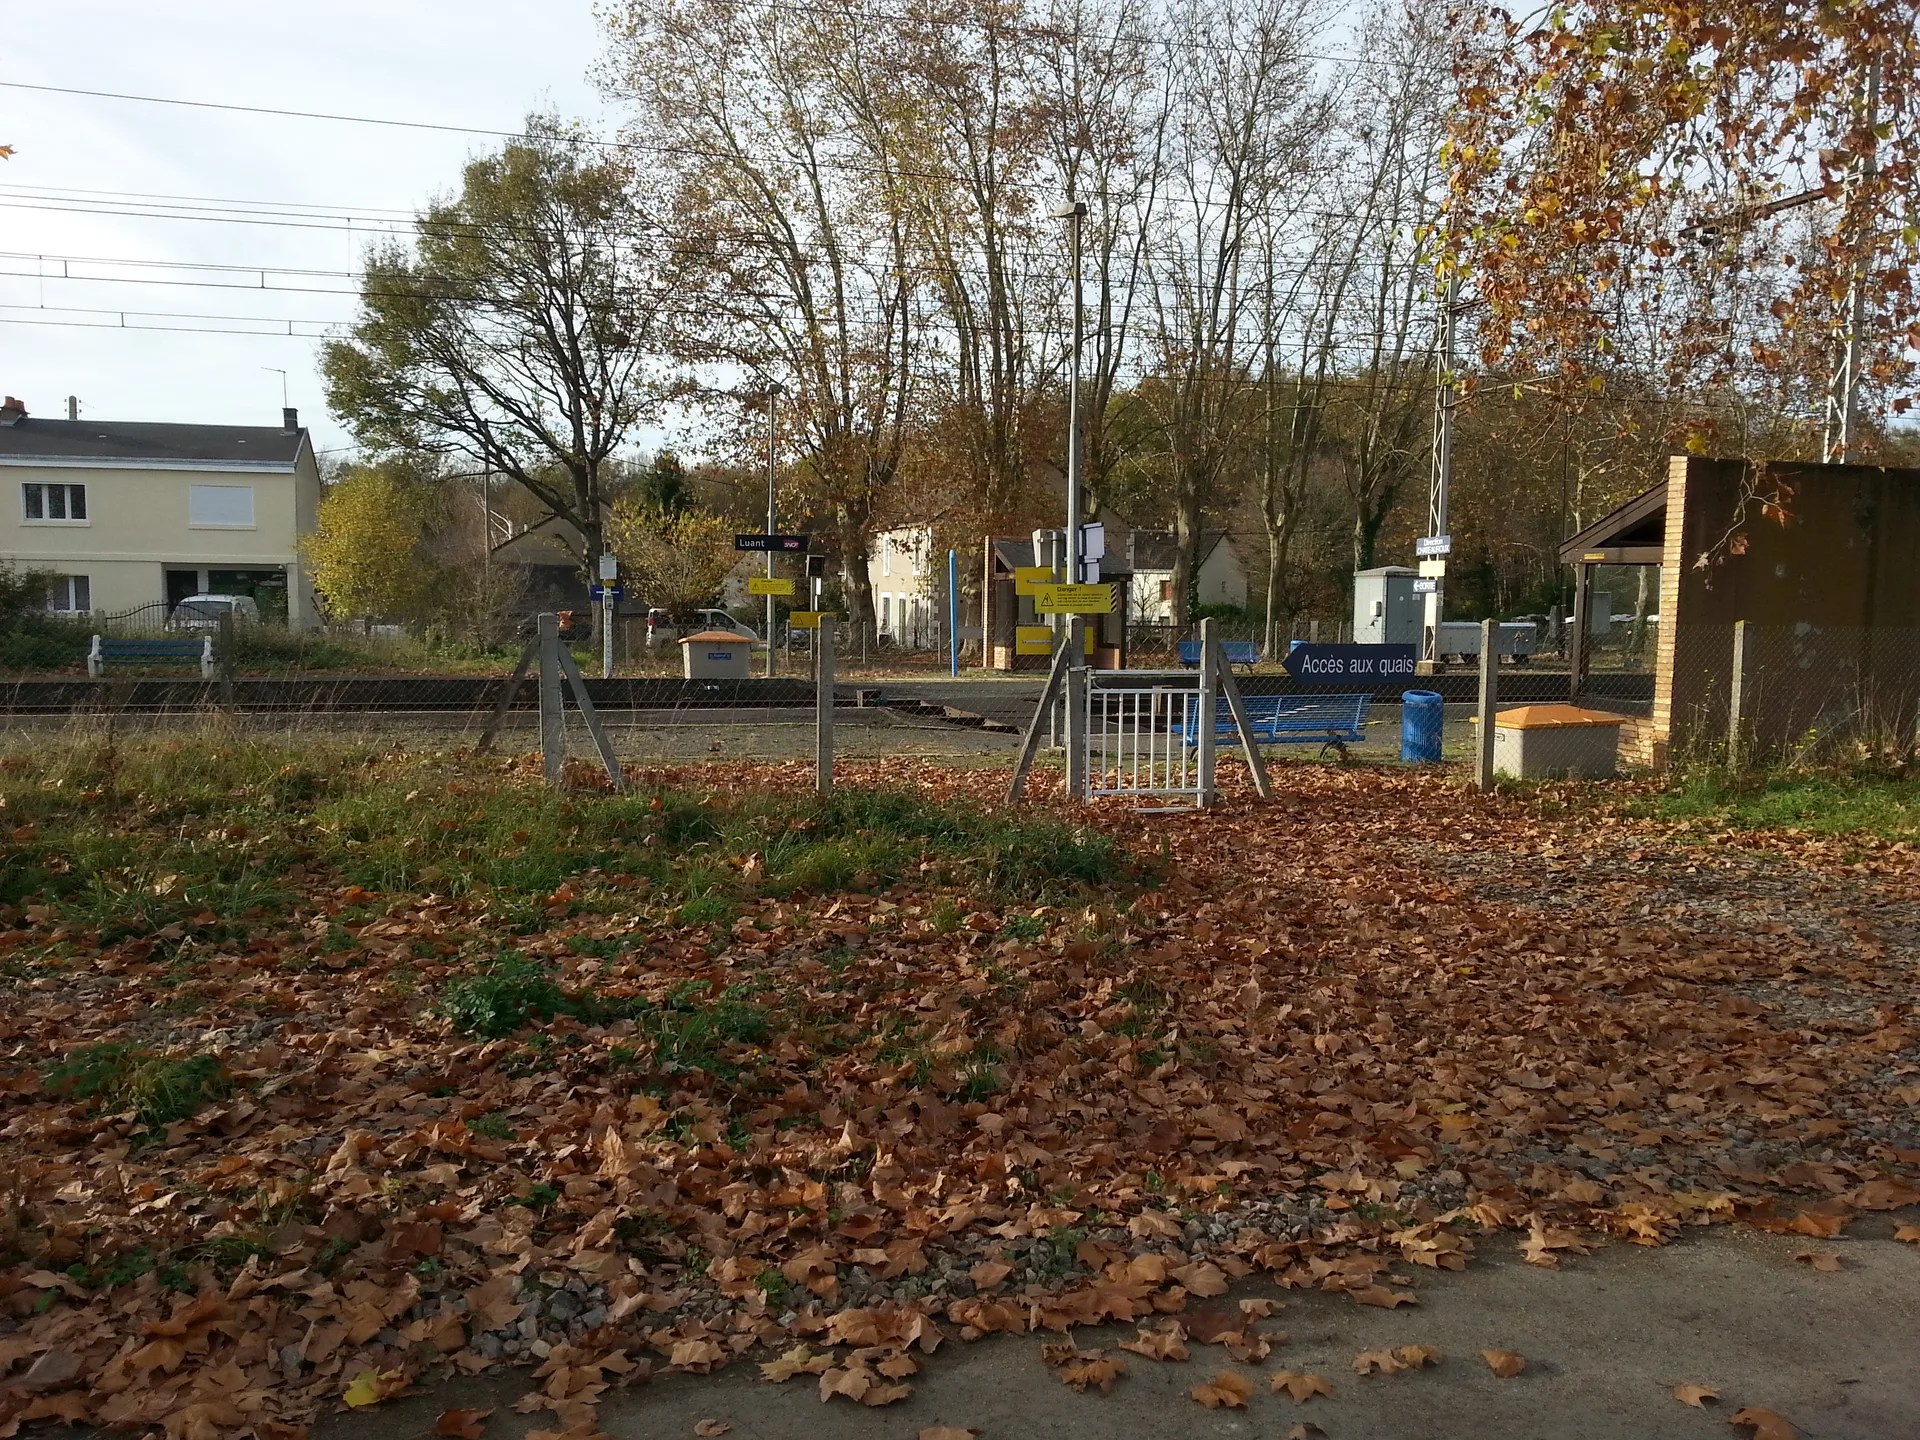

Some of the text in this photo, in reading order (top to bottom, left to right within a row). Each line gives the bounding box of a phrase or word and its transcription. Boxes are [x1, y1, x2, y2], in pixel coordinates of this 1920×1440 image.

[739, 538, 765, 547] Luant
[1301, 654, 1414, 677] Accès aux quais
